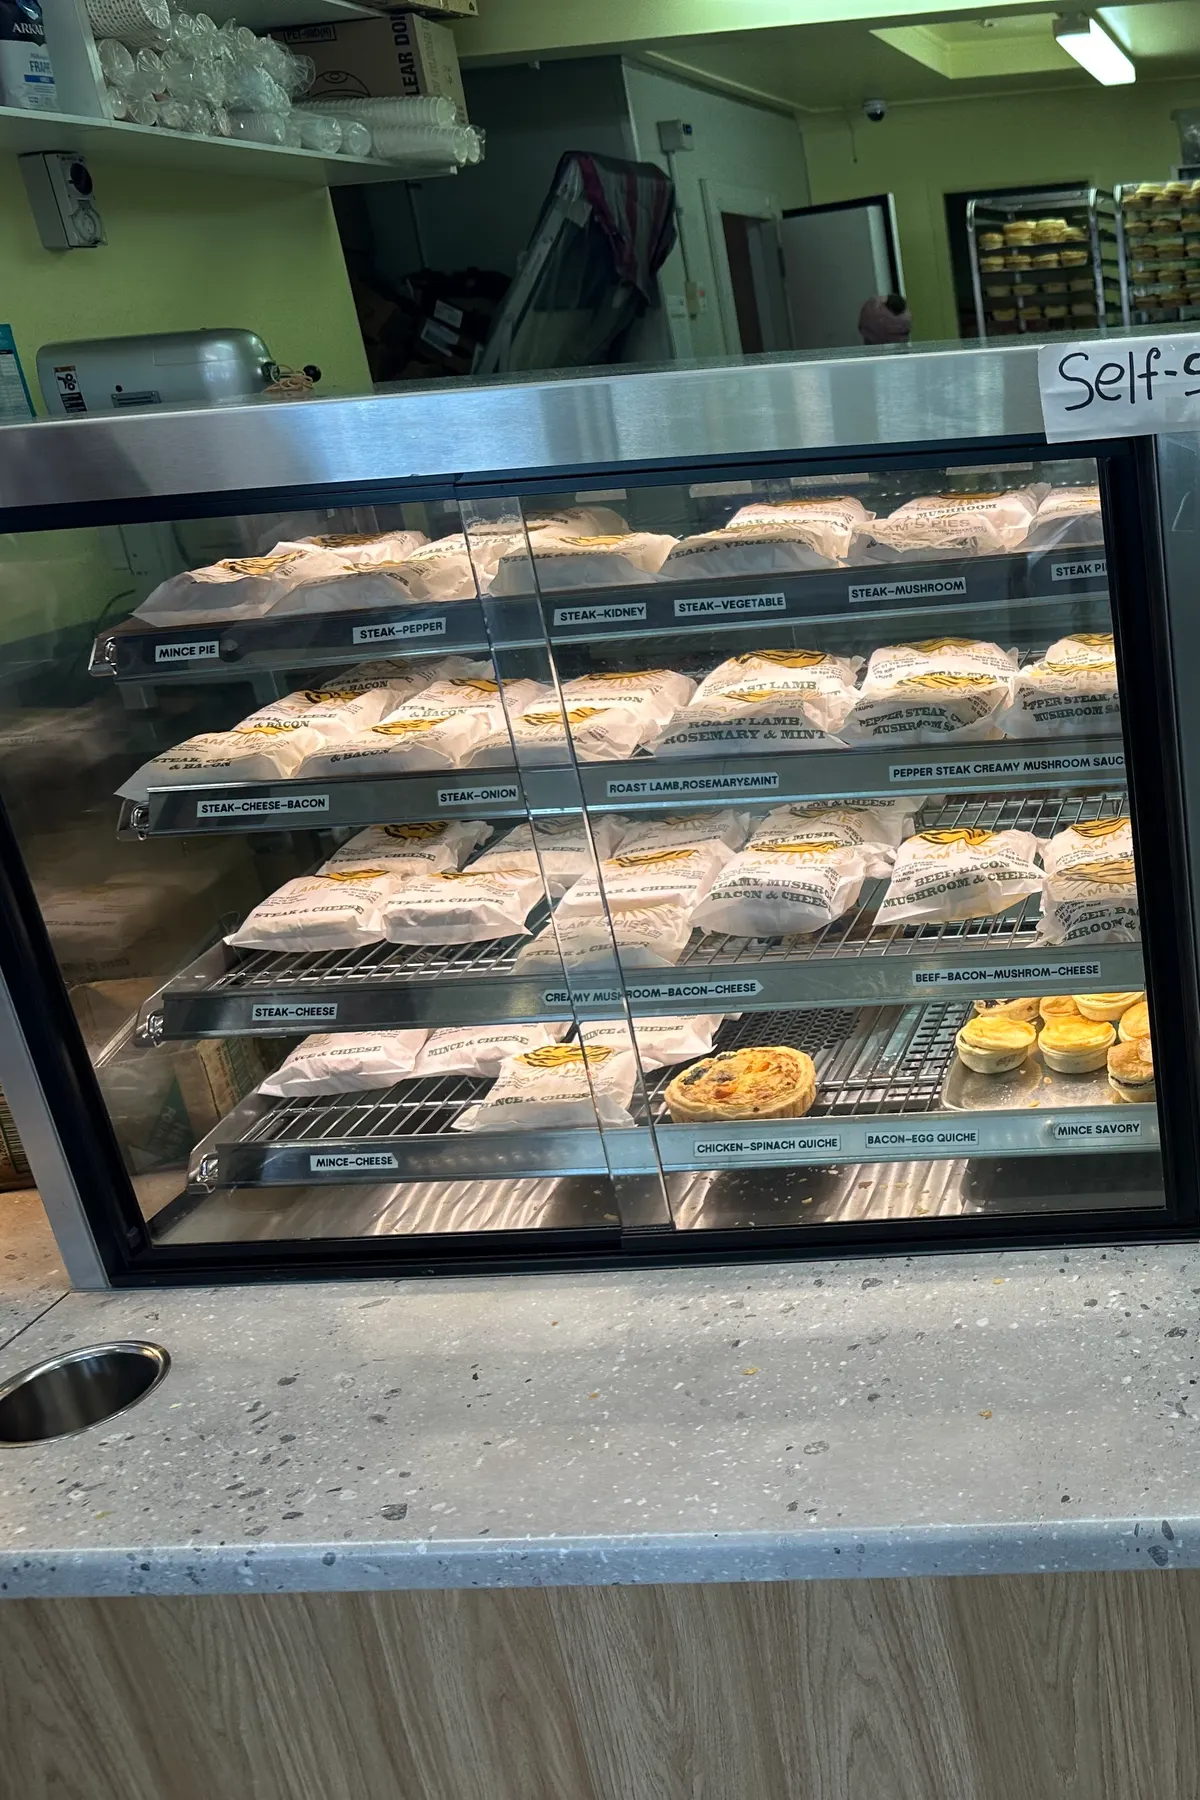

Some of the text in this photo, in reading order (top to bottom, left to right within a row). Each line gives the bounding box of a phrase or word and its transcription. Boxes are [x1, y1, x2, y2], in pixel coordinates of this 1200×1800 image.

[397, 52, 420, 97] LEAR
[1055, 561, 1108, 578] STEAK PI
[851, 580, 964, 598] STEAK-MUSHROOM
[678, 597, 784, 613] STEAK-VEGETABLE
[560, 607, 645, 621] STEAK-KIDNEY
[359, 620, 444, 640] STEAK-PEPPER
[158, 643, 216, 659] MINCE PIE
[422, 708, 468, 717] BACON
[266, 719, 310, 729] BACON
[763, 730, 778, 739] &
[780, 729, 826, 739] MINT
[893, 766, 933, 778] PEPPER
[935, 764, 971, 776] STEAK
[973, 762, 1020, 773] CREAMY
[1023, 758, 1091, 771] MUSHROOM
[440, 788, 517, 803] STEAK-ONION
[609, 782, 647, 794] ROAST
[201, 798, 325, 814] STEAK-CHEESE-BACON
[882, 879, 971, 909] MUSHROOM
[973, 874, 985, 885] &
[545, 991, 590, 1002] CREAMY
[255, 1006, 335, 1018] STEAK-CHEESE
[1057, 1123, 1140, 1136] MINCE SAVORY
[867, 1131, 976, 1145] BACON-EGG QUICHE
[696, 1138, 838, 1154] CHICKEN-SPINACH QUICHE
[316, 1155, 393, 1168] MINCE-CHEESE
